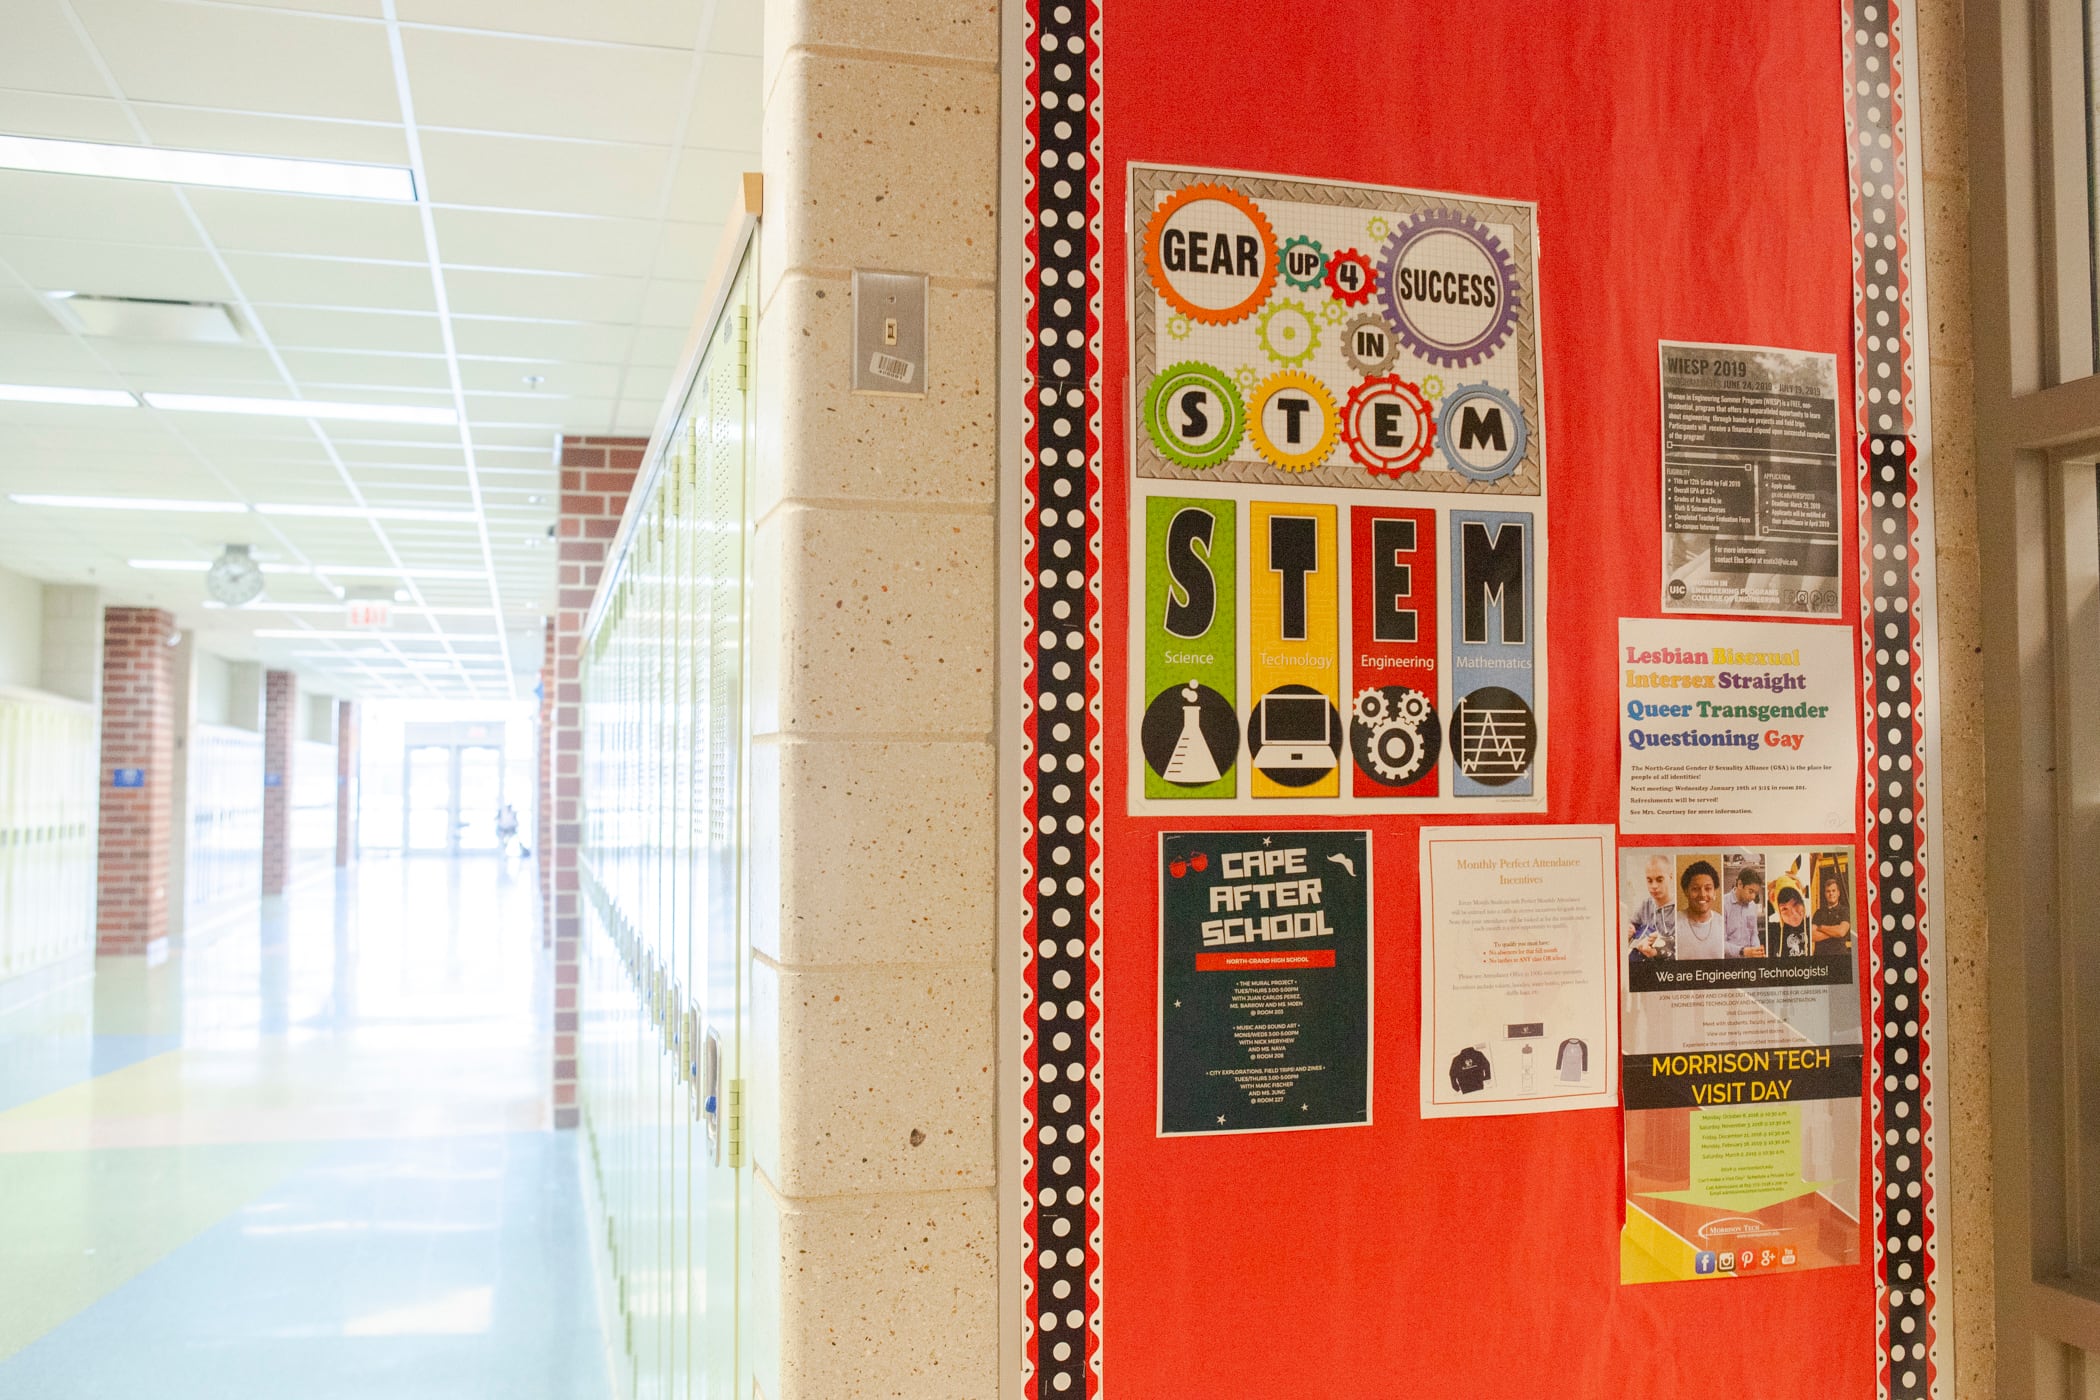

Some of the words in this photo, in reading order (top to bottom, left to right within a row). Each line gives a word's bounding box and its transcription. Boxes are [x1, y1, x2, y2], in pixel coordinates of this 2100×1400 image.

[1163, 229, 1259, 277] GEAR
[1288, 252, 1319, 276] UP
[1340, 264, 1358, 291] 4
[1400, 267, 1496, 308] SUCCESS
[1357, 332, 1384, 357] IN
[1667, 357, 1709, 375] WIESP
[1714, 360, 1747, 378] 2019
[1723, 380, 1740, 389] JUNE
[1755, 382, 1772, 391] 2019
[1780, 384, 1793, 393] JULY
[1805, 386, 1821, 396] 2019
[1669, 586, 1686, 594] UIC
[1164, 651, 1214, 666] Science
[1260, 652, 1333, 669] Technology
[1361, 654, 1435, 671] Engineering
[1456, 655, 1532, 670] Mathematics
[1626, 646, 1709, 665] Lesbian
[1712, 648, 1800, 666] Bisexual
[1625, 669, 1716, 689] Intersex
[1718, 671, 1807, 693] Straight
[1627, 700, 1692, 721] Queer
[1696, 701, 1829, 722] Transgender
[1628, 729, 1760, 750] Questioning
[1764, 729, 1804, 751] Gay
[1221, 848, 1307, 879] CAPE
[1457, 859, 1496, 870] Monthly
[1500, 858, 1530, 869] Perfect
[1533, 858, 1580, 868] Attendance
[1500, 875, 1543, 885] Incentives
[1209, 878, 1322, 913] AFTER
[1201, 910, 1334, 947] SCHOOL
[1656, 971, 1673, 982] We
[1676, 973, 1692, 982] are
[1696, 968, 1757, 983] Engineering
[1758, 965, 1829, 980] Technologists!
[1652, 1052, 1770, 1076] MORRISON
[1774, 1049, 1830, 1070] TECH
[1691, 1082, 1746, 1104] VISIT
[1751, 1080, 1792, 1101] DAY
